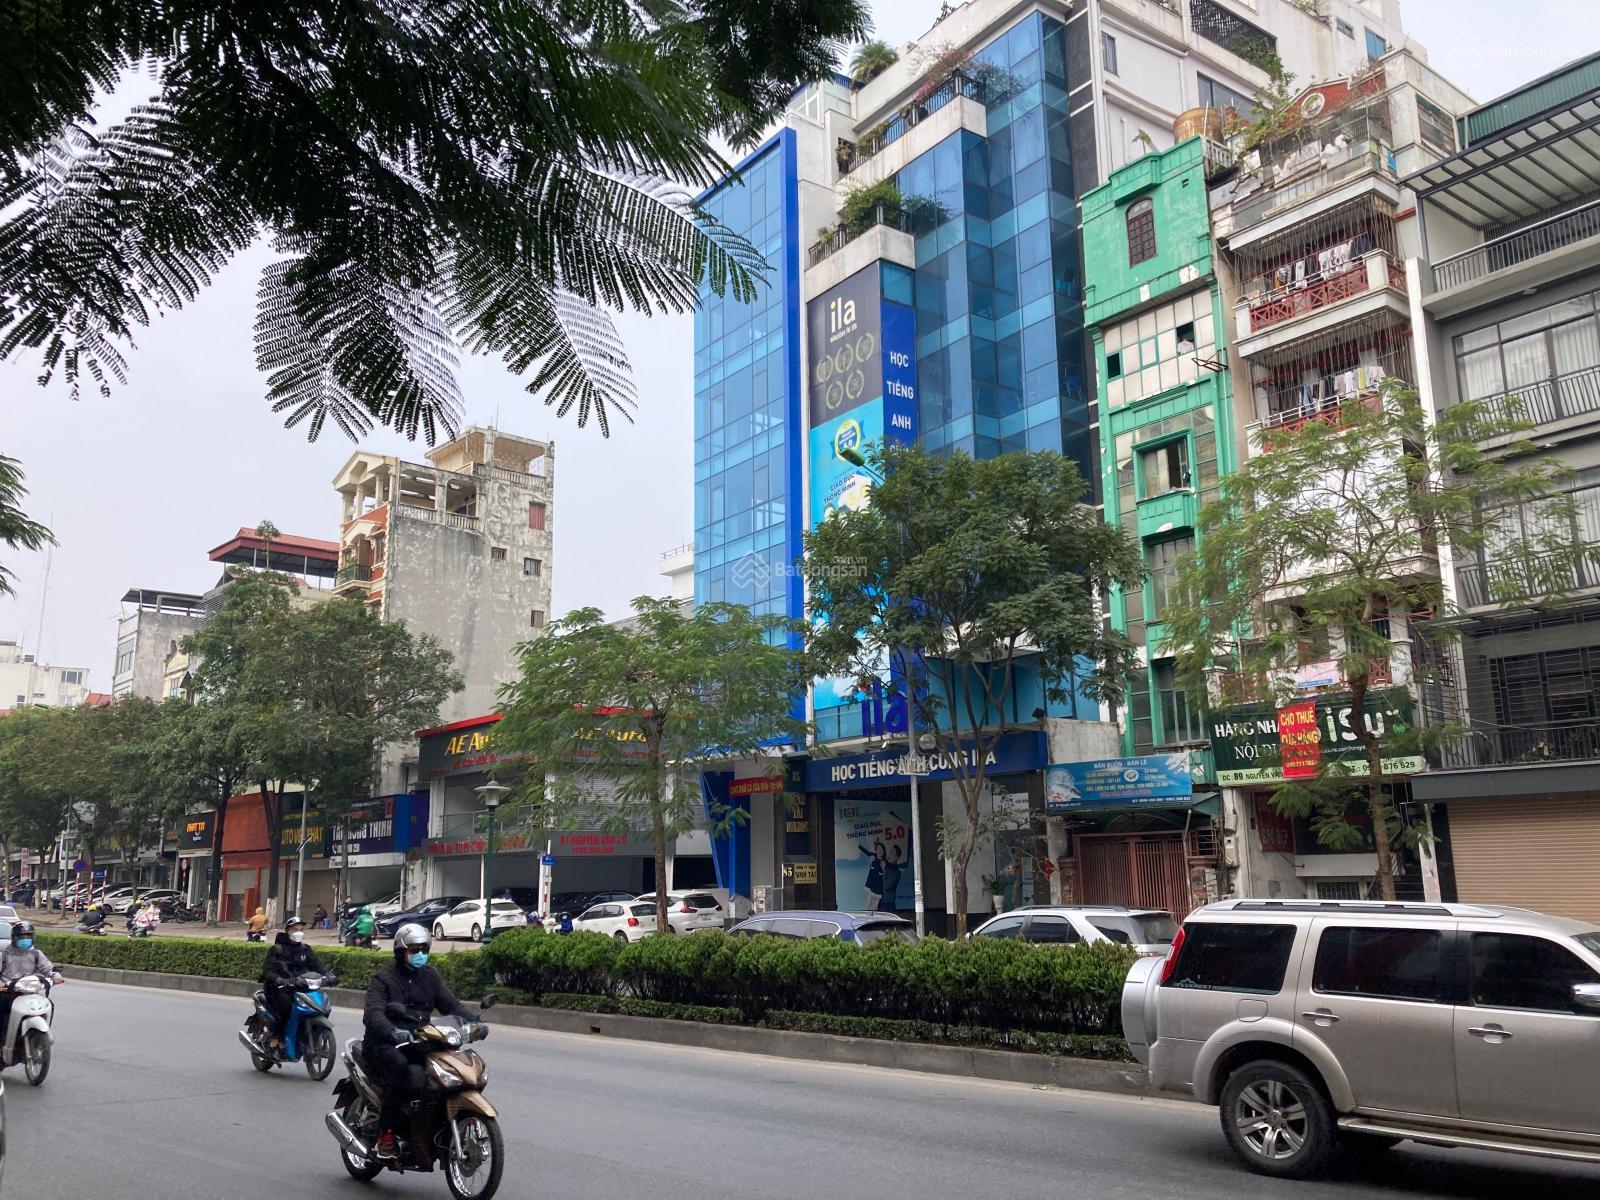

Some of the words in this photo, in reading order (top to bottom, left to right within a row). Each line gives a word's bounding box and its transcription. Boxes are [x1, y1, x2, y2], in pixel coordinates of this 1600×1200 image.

[830, 297, 856, 334] ila
[890, 351, 909, 368] HỌC
[887, 379, 914, 400] TIẾNG
[891, 414, 911, 430] ANH
[1280, 712, 1295, 726] CHO
[831, 764, 857, 784] HỌC
[857, 754, 896, 779] TIẾNG
[369, 820, 392, 841] THỊNH
[884, 825, 905, 841] 5.0
